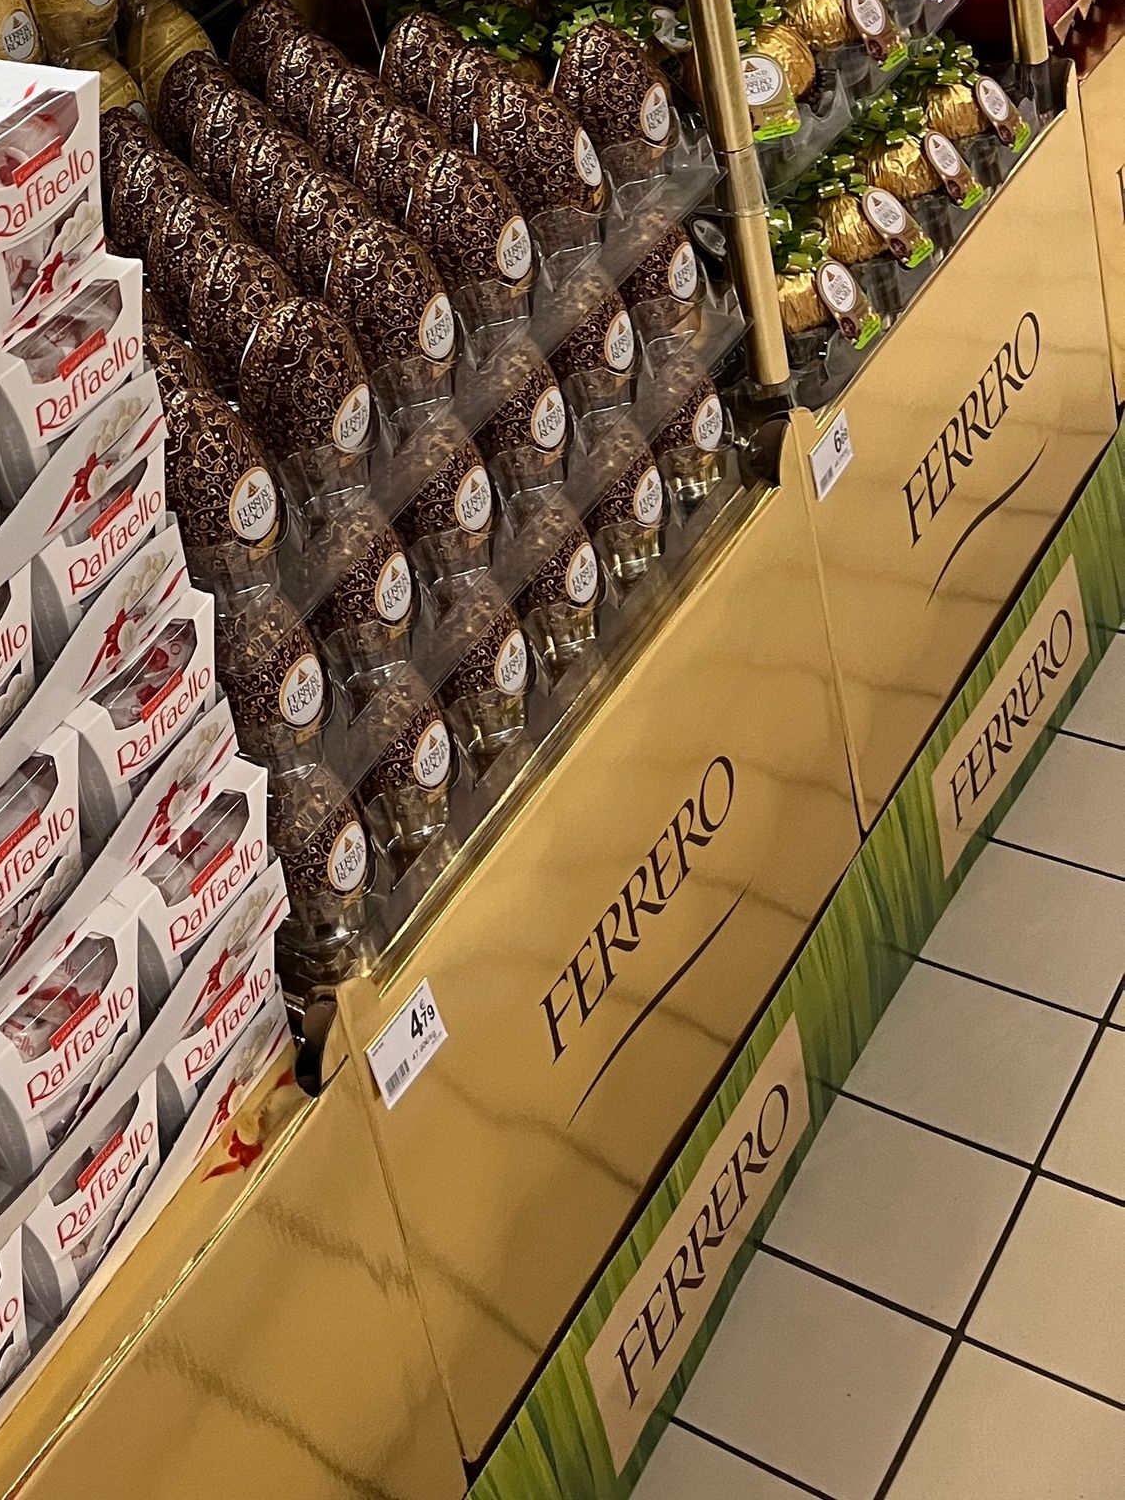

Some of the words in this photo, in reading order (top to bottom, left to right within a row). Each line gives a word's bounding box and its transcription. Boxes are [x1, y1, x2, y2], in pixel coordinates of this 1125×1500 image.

[34, 326, 137, 436] Raffaello
[901, 310, 1040, 548] FERRERO
[67, 489, 162, 595] Raffaello
[117, 665, 211, 777] Raffaello
[948, 609, 1073, 830] FERRERO
[169, 838, 264, 951] Raffaello
[538, 755, 736, 1066] FERRERO
[26, 983, 135, 1109] Raffaello
[184, 967, 272, 1083] Raffaello
[56, 1121, 154, 1250] Raffaello
[615, 1083, 791, 1409] FERRERO
